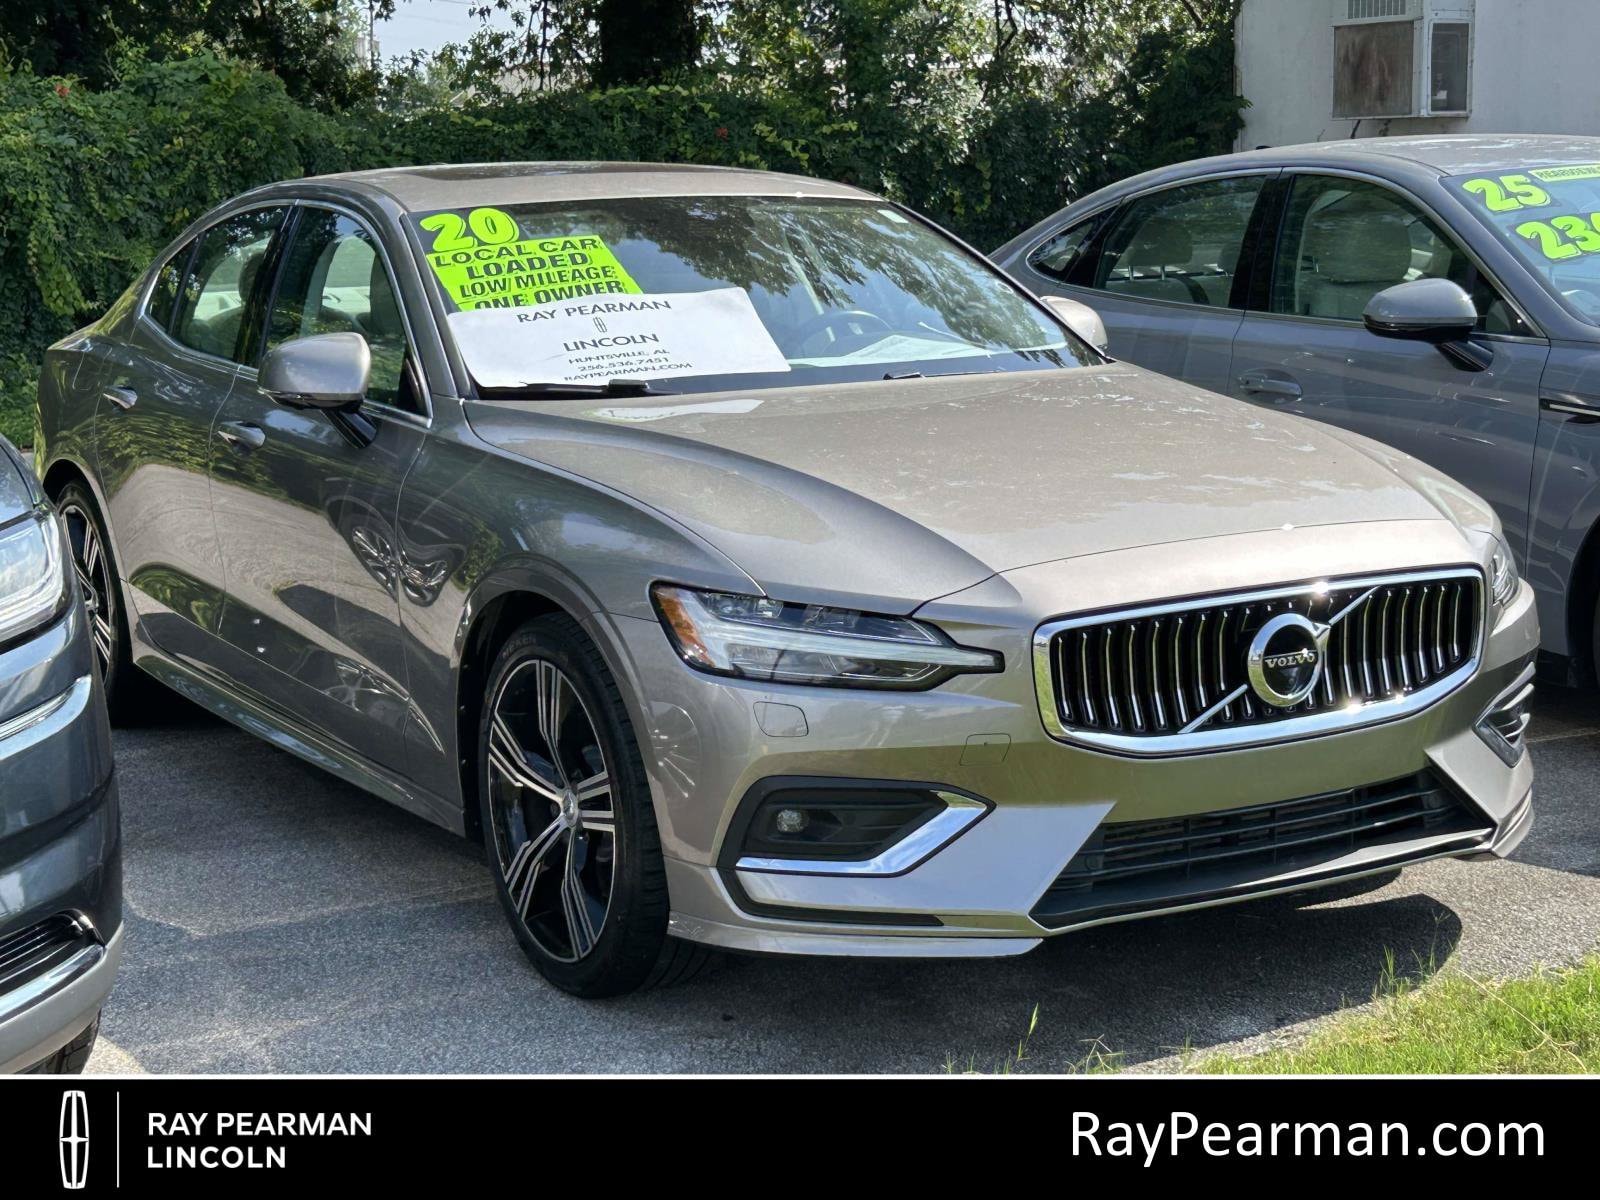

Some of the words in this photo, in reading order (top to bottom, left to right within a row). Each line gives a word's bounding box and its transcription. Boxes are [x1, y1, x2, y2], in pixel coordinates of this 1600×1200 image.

[1462, 174, 1551, 212] 25
[420, 208, 519, 252] 20
[435, 244, 532, 268] LOCAL
[539, 238, 600, 253] CAR
[466, 252, 590, 280] LOADED
[460, 278, 508, 298] LOW
[515, 265, 615, 289] MILEAGE
[533, 280, 623, 304] OWNER
[517, 309, 557, 323] RAY
[565, 300, 672, 317] PEARMAN
[563, 333, 659, 352] LINCOLN
[564, 363, 693, 381] RAYPEARMAN.COM
[1265, 652, 1315, 668] VOLVO
